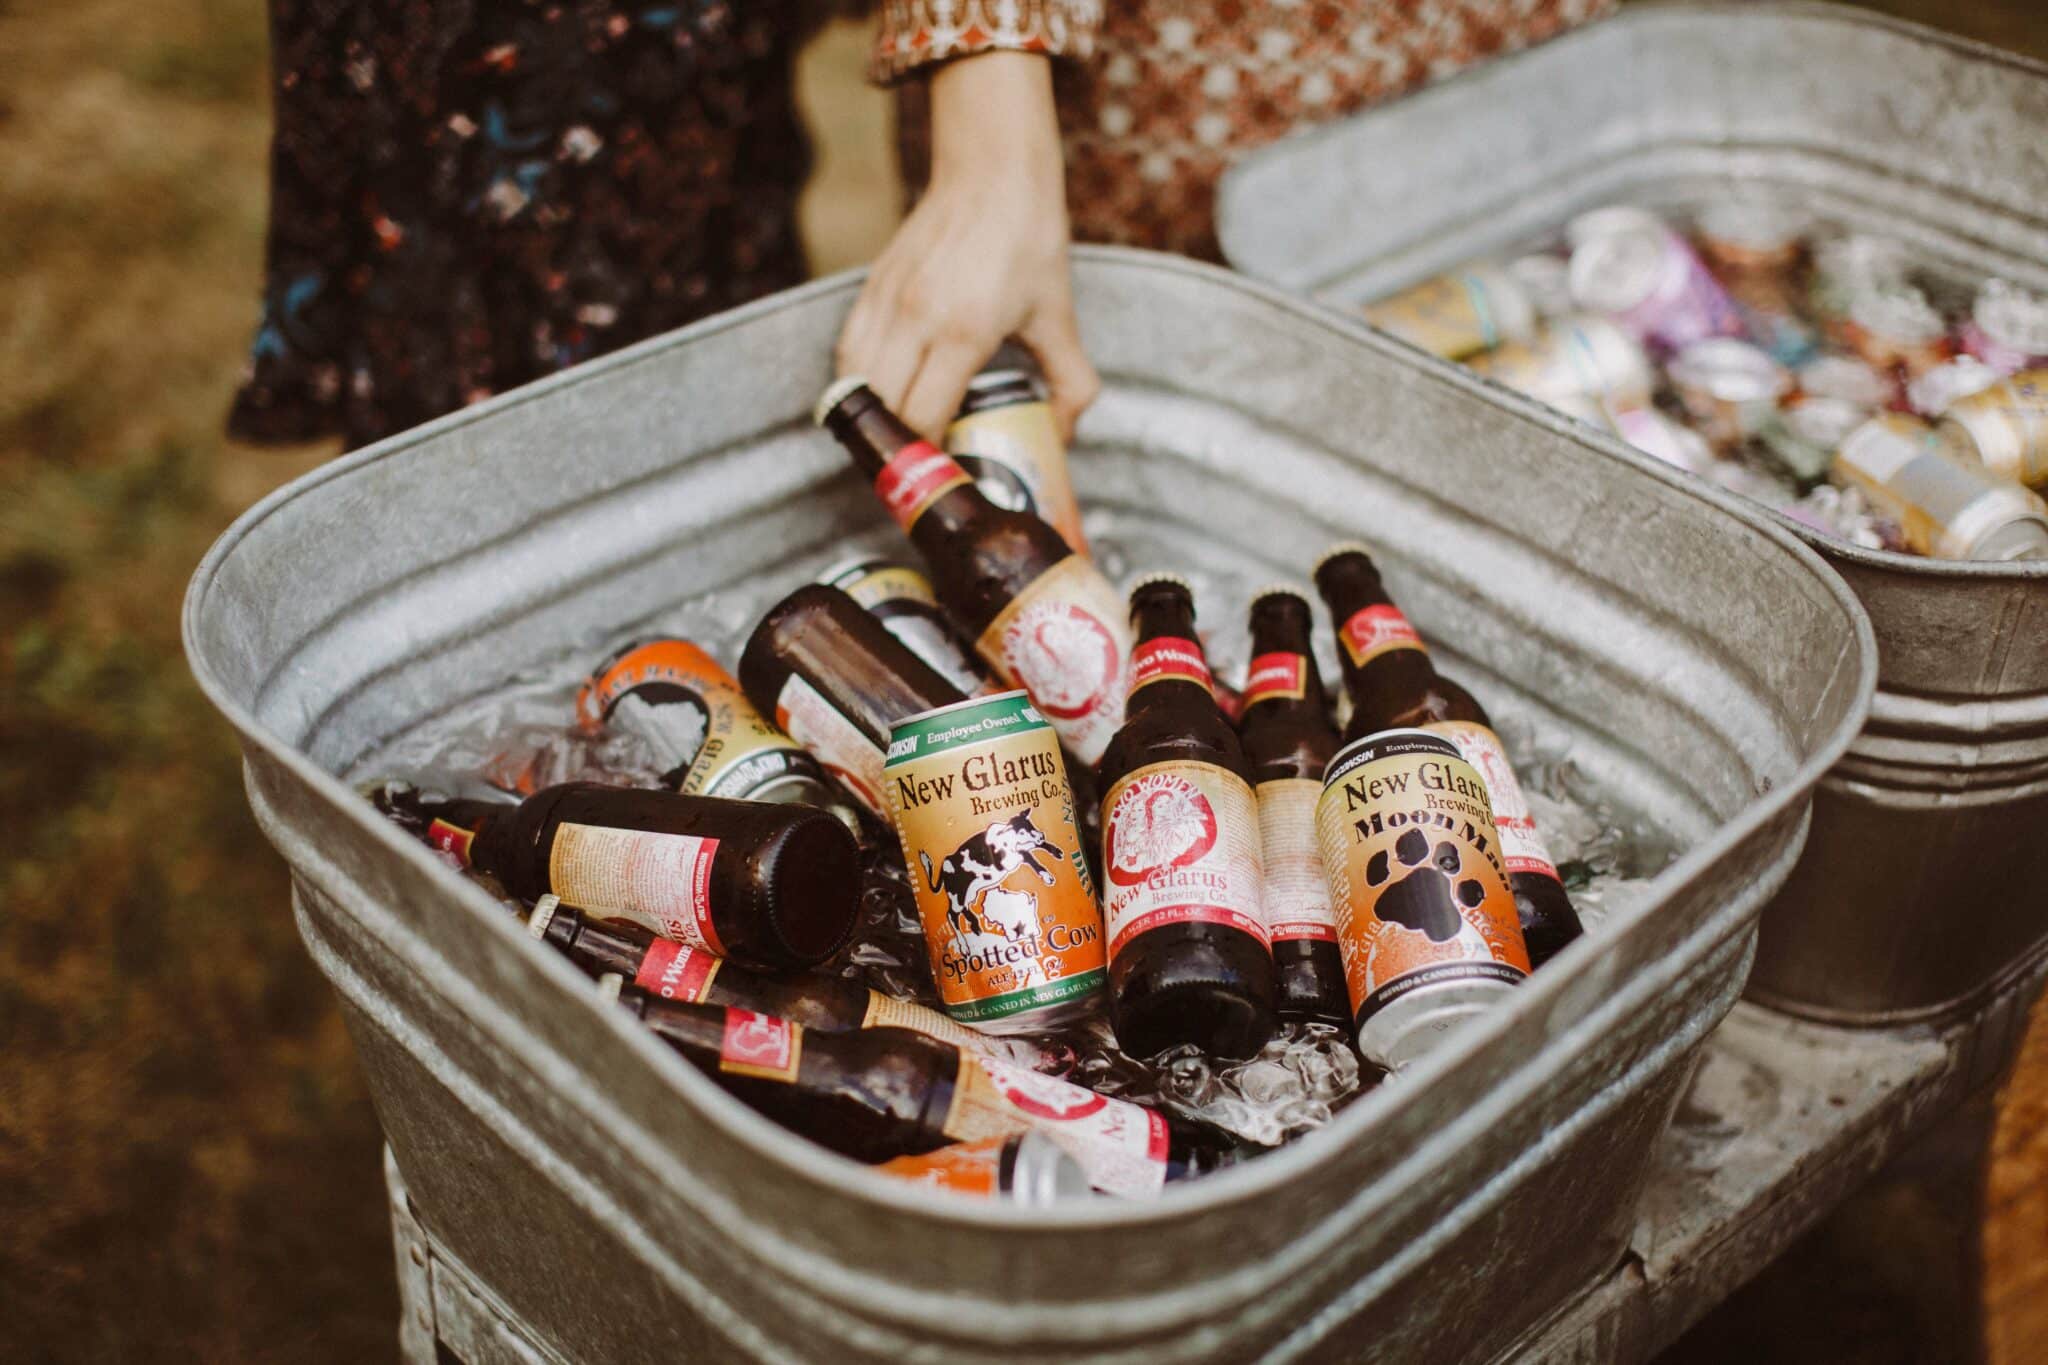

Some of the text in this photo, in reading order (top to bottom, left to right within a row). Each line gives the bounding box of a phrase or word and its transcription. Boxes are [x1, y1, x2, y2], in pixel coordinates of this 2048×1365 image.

[927, 723, 982, 744] Employee
[982, 712, 1021, 730] Owned
[896, 751, 1056, 811] New Glarus
[970, 779, 1063, 816] Brewing Co.
[1132, 773, 1201, 801] WOMEN
[1343, 762, 1490, 813] New Glaru
[1424, 793, 1485, 825] Brewing
[1353, 810, 1455, 844] Moon
[1109, 864, 1228, 921] New Glarus
[1152, 888, 1203, 905] Brewing
[942, 933, 1041, 984] Spotted
[1047, 923, 1098, 951] Cow
[988, 972, 1010, 987] ALE
[981, 1000, 1018, 1016] CANNED
[1020, 996, 1031, 1007] IN
[1032, 991, 1054, 1003] NEW
